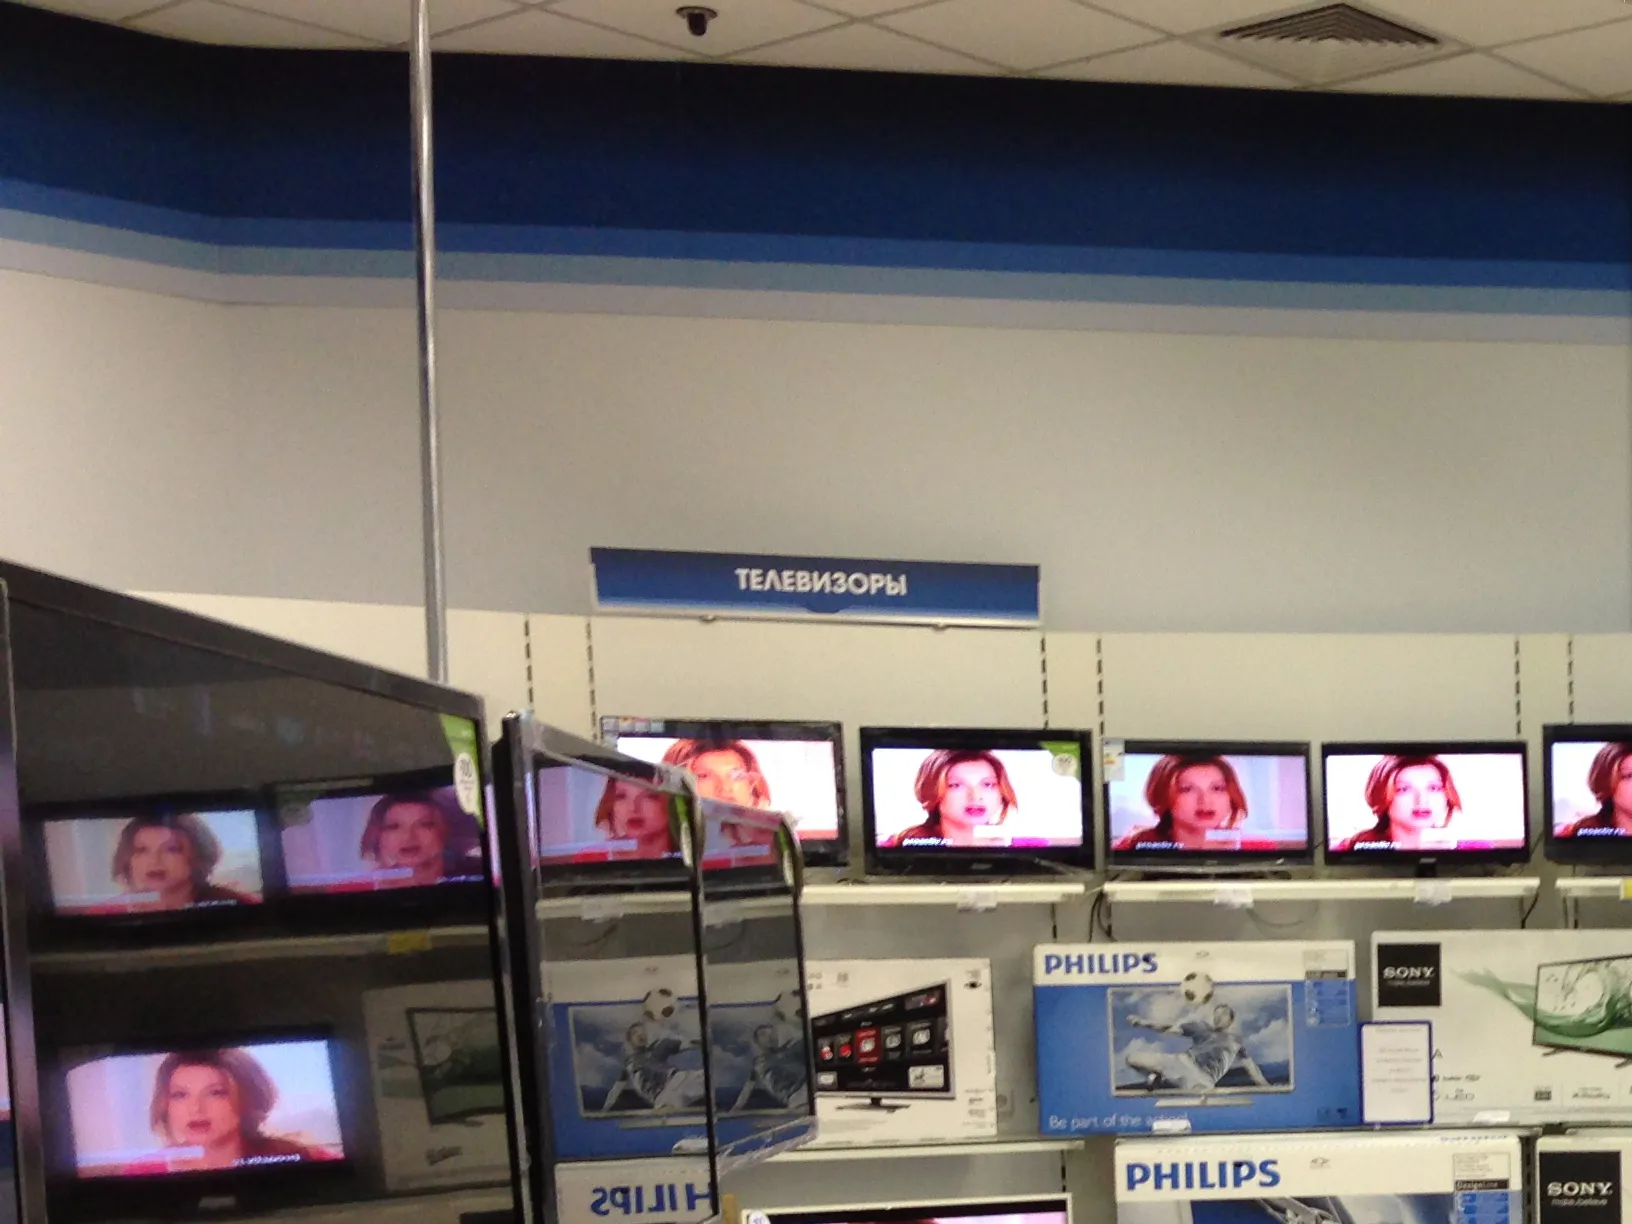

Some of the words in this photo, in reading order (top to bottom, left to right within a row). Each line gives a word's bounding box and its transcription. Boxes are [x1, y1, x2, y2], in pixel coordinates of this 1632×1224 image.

[734, 567, 908, 597] ТЕЛЕВИЗОРЫ
[1044, 953, 1158, 975] PHILIPS
[1382, 965, 1436, 979] SONY
[1049, 1114, 1067, 1130] Be
[1071, 1115, 1100, 1132] part
[1103, 1112, 1118, 1128] of
[1120, 1114, 1142, 1128] the
[1127, 1159, 1281, 1191] PHILIPS
[1546, 1181, 1613, 1197] SONY
